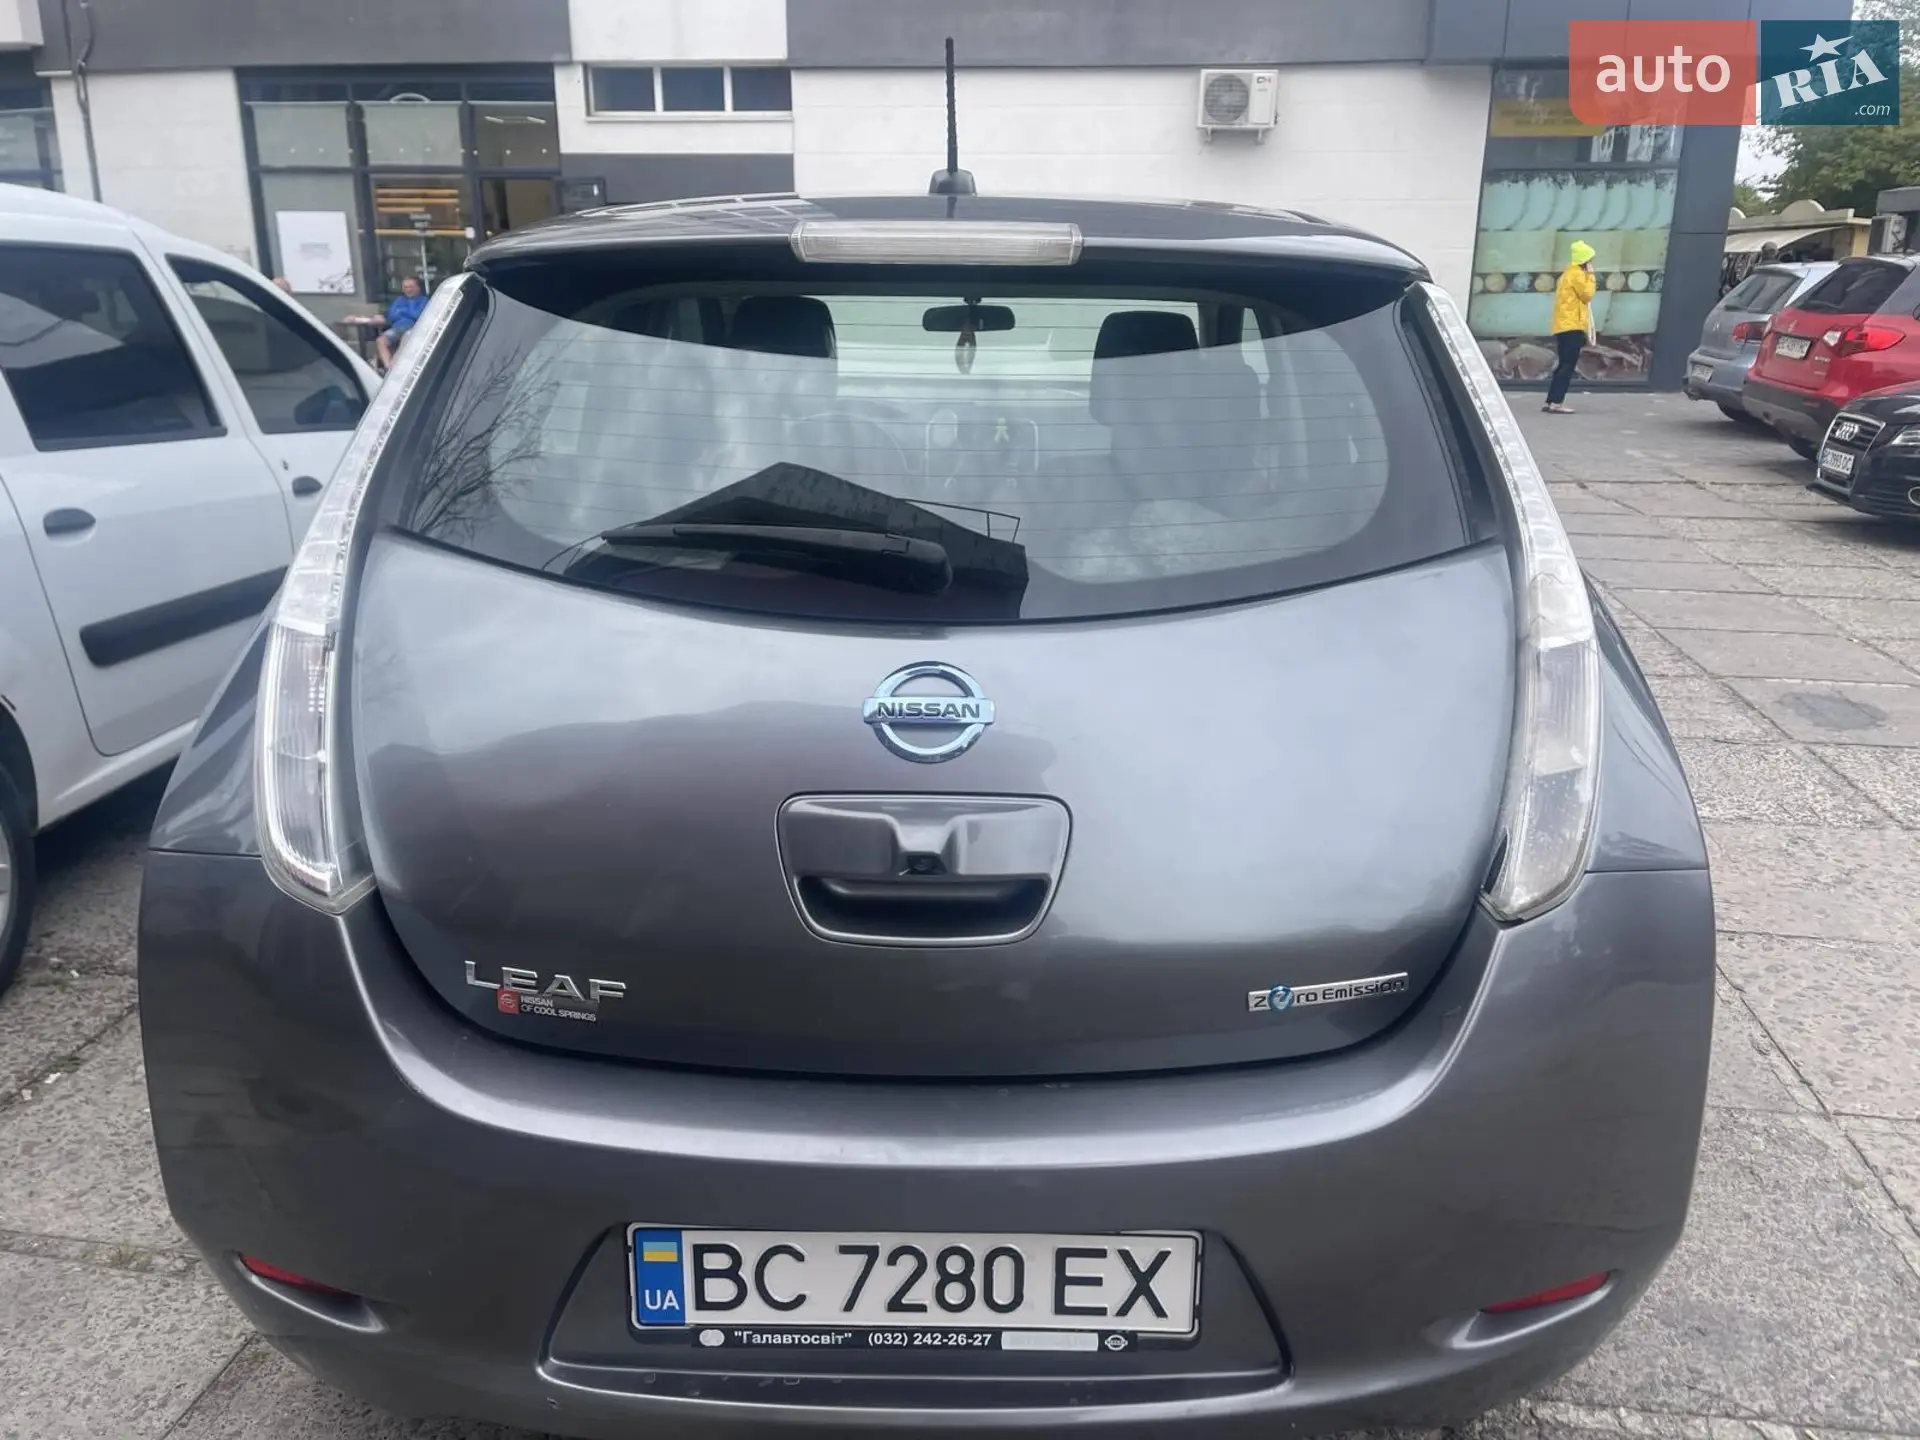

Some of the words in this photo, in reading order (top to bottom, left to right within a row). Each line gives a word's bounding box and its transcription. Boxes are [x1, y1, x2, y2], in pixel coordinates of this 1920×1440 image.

[877, 702, 980, 718] NISSAN
[465, 960, 627, 1003] LEAF
[1322, 979, 1405, 1000] Emission
[521, 995, 554, 1007] NISSAN
[521, 1004, 533, 1013] OF
[534, 1006, 557, 1016] COOL
[558, 1009, 596, 1022] SPRINGS
[692, 1242, 807, 1312] BC
[837, 1243, 1026, 1314] 7280
[1053, 1246, 1172, 1318] EX
[645, 1288, 680, 1312] UA
[734, 1331, 852, 1345] "Галавтосвіт"
[868, 1331, 908, 1346] (032)
[912, 1332, 992, 1346] 242-26-27
